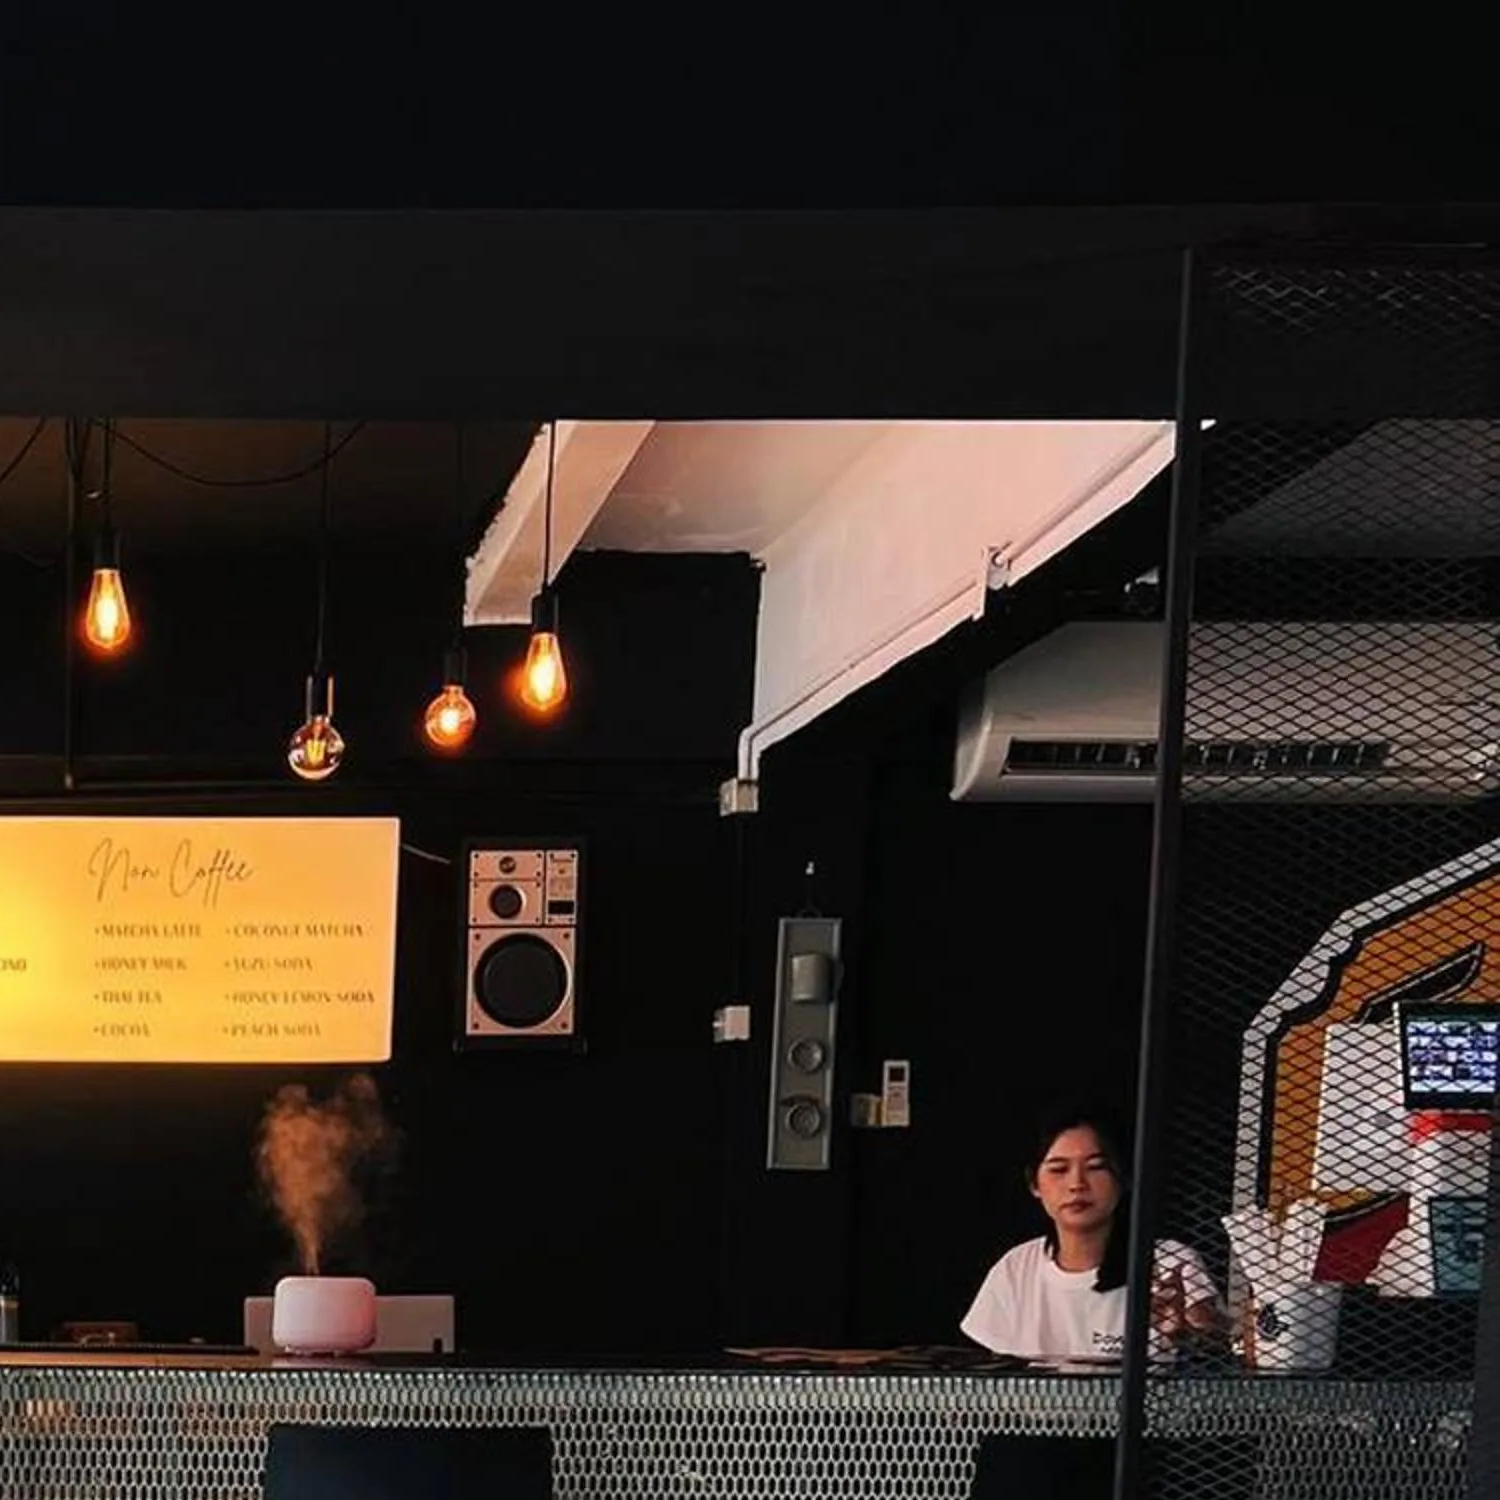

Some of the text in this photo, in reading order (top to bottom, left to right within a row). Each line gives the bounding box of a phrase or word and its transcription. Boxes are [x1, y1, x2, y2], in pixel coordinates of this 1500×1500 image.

[88, 837, 254, 908] Non Coffee
[305, 924, 363, 938] MATCHA
